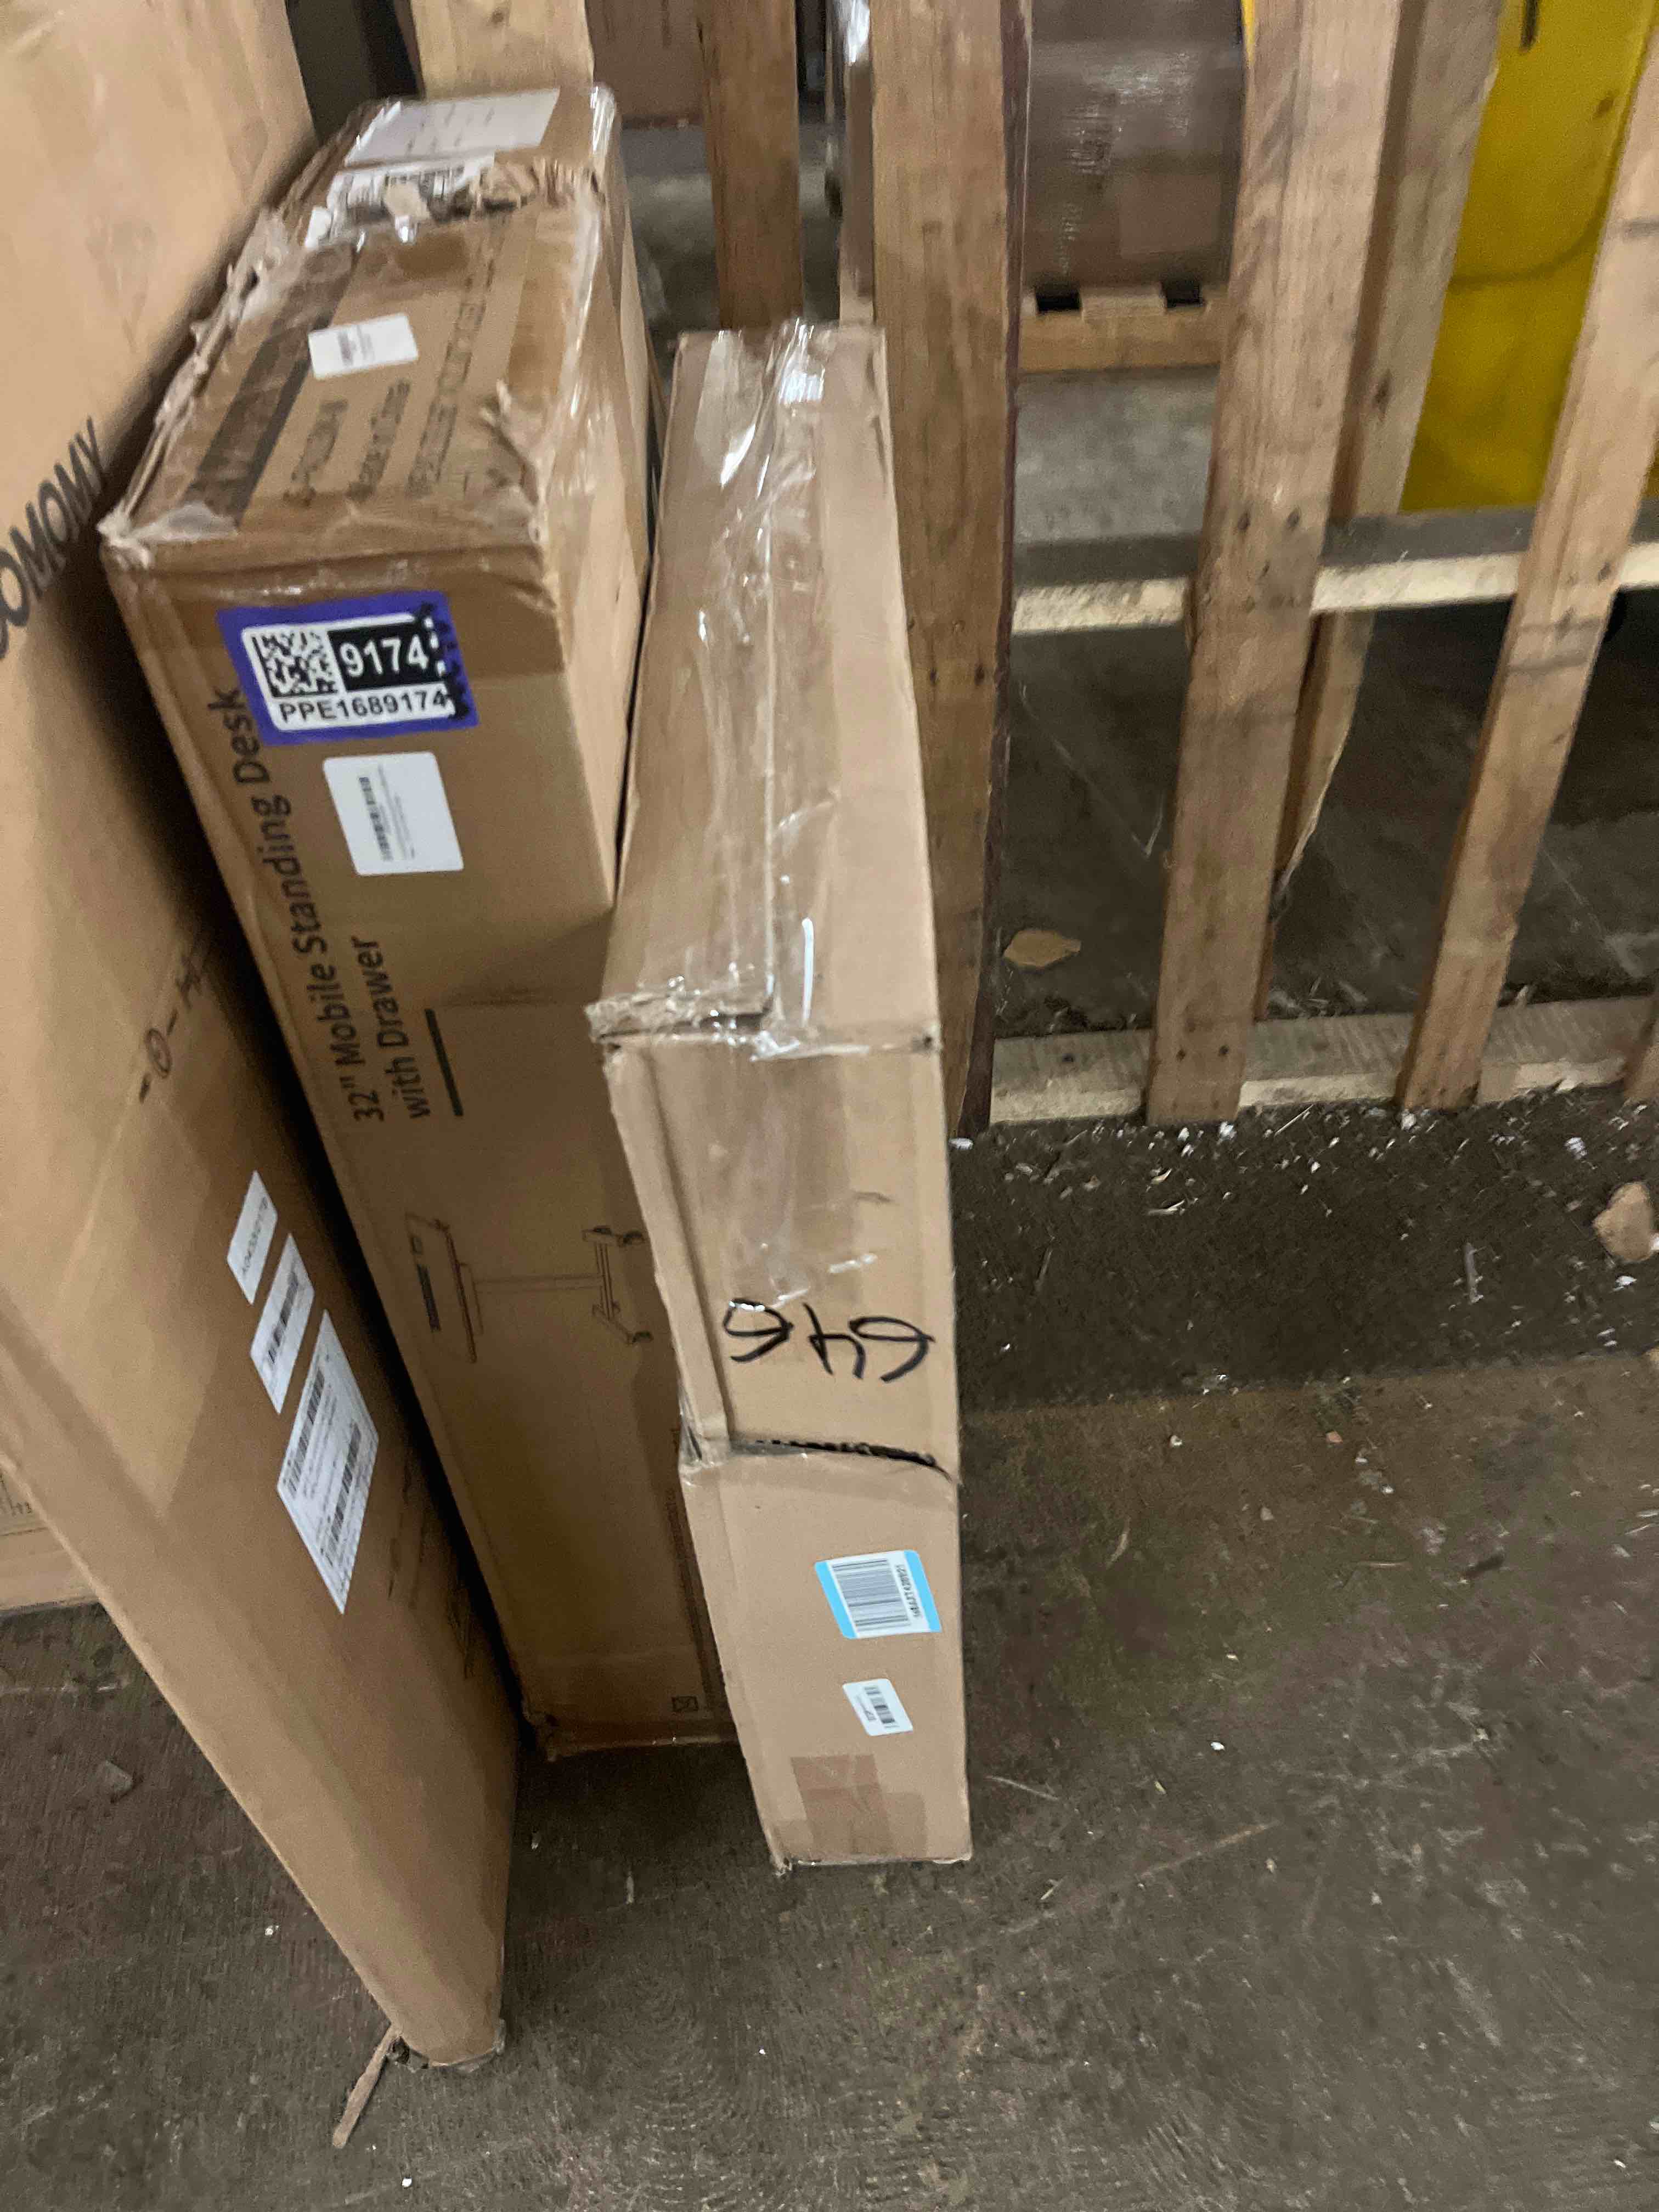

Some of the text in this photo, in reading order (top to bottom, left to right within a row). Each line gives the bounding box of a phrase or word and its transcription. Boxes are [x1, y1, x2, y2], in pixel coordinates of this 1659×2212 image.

[279, 689, 448, 724] PPE1689174
[339, 633, 430, 676] 9174
[207, 687, 384, 1121] 32" Mobile Standing Desk
[351, 935, 431, 1120] with Drawer
